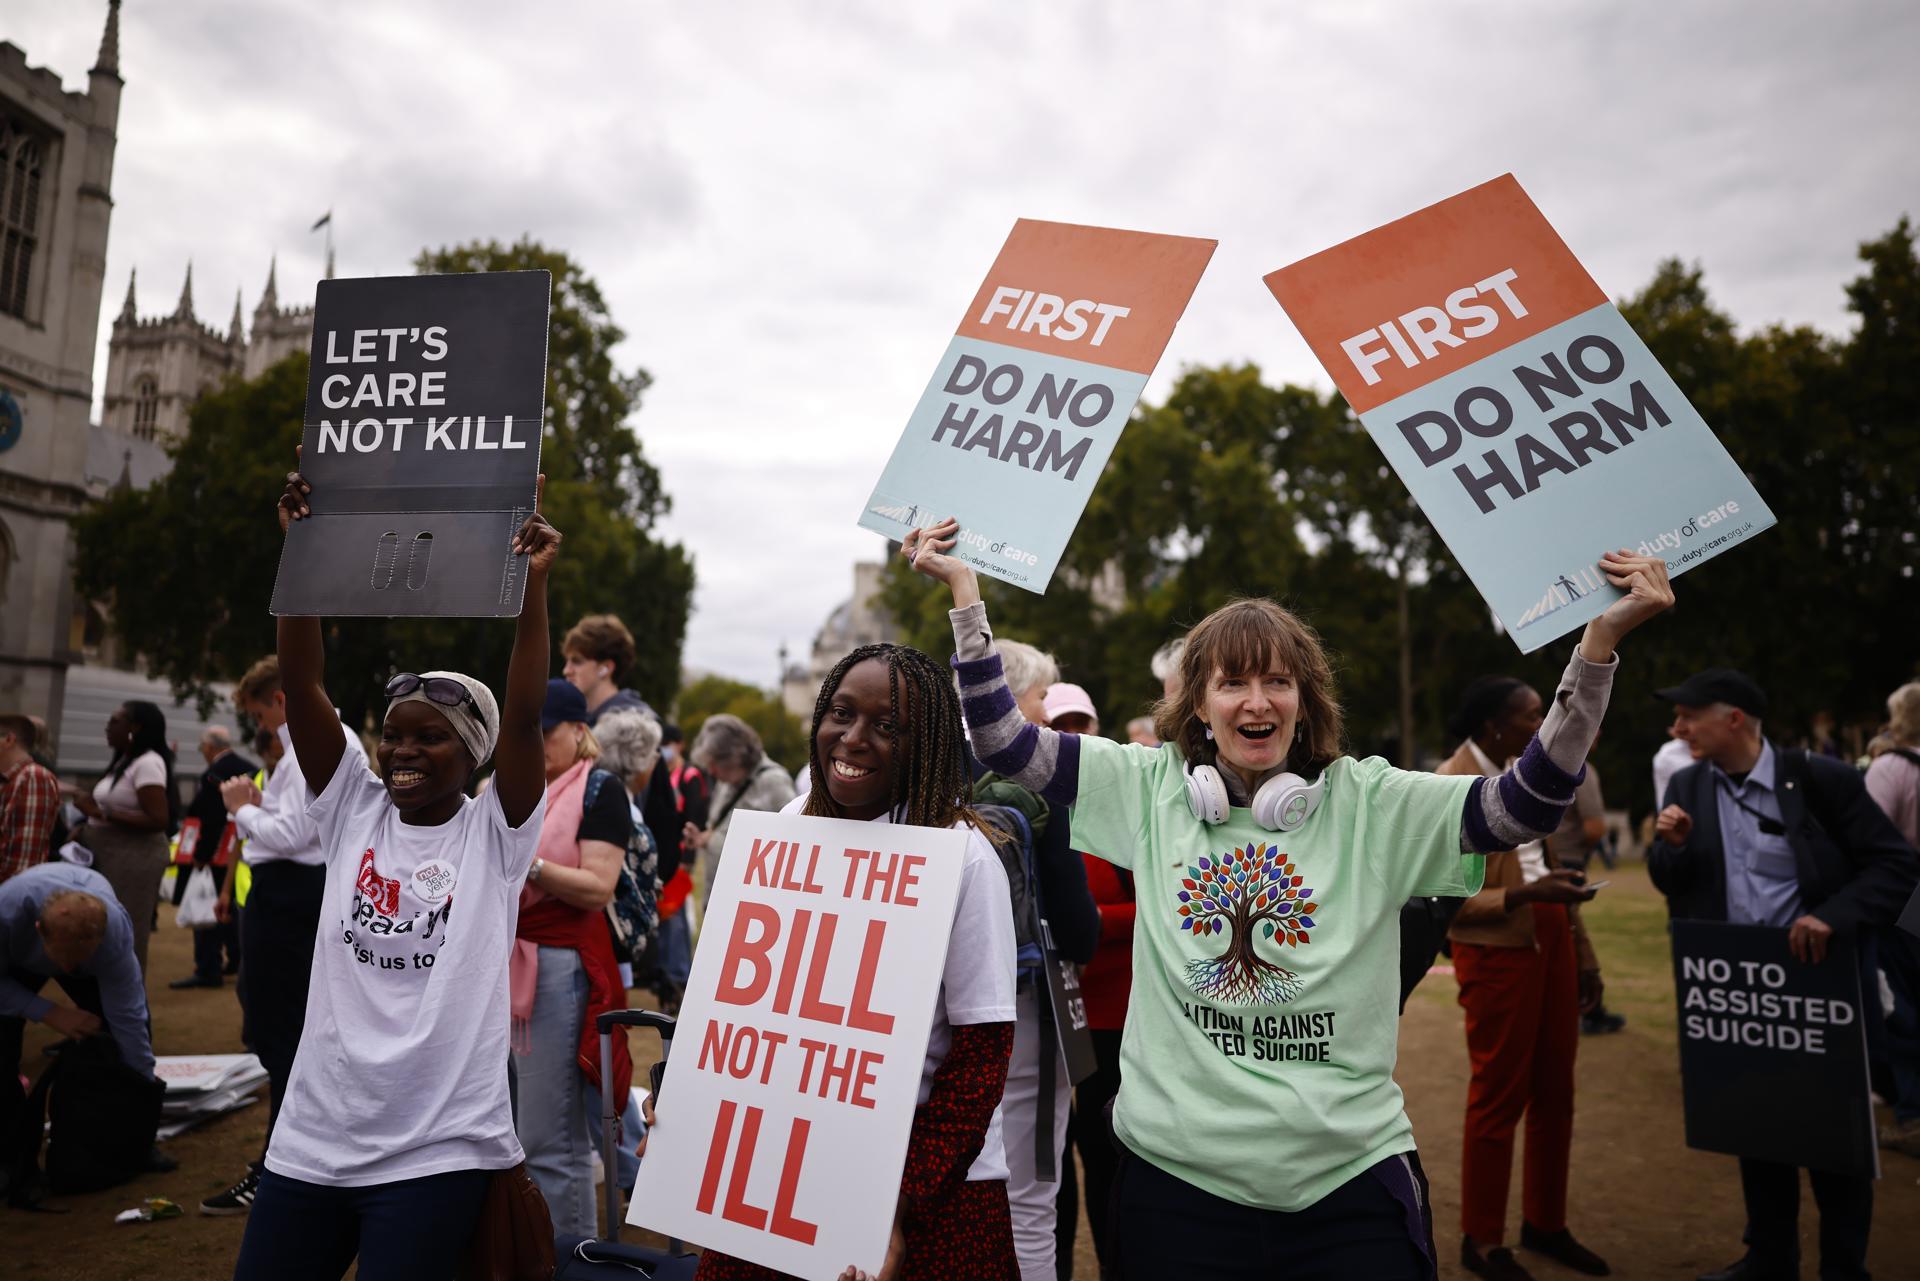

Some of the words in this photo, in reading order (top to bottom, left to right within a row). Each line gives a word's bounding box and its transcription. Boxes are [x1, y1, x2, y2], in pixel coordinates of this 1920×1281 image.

[979, 285, 1131, 347] FIRST
[1339, 268, 1530, 386] FIRST
[325, 326, 449, 364] LET'S
[321, 371, 447, 410] CARE
[942, 354, 1024, 406] DO
[1026, 372, 1115, 428] NO
[1395, 386, 1514, 468] DO
[1511, 334, 1626, 413] NO
[317, 416, 414, 454] NOT
[424, 414, 527, 452] KILL
[931, 402, 1094, 482] HARM
[1451, 379, 1673, 515] HARM
[957, 527, 991, 552] duty
[990, 541, 1008, 555] of
[1003, 545, 1039, 567] care
[1637, 529, 1681, 557] duty
[1681, 517, 1699, 538] of
[1697, 499, 1741, 529] care
[1666, 519, 1754, 571] Ourdutyofcare.org.uk
[419, 866, 438, 880] not
[425, 868, 451, 888] dead
[743, 838, 824, 895] KILL
[842, 848, 927, 907] THE
[380, 956, 406, 970] us
[413, 952, 436, 969] to
[713, 900, 896, 1036] BILL
[1682, 956, 1732, 984] NO
[1739, 961, 1787, 988] TO
[1251, 1011, 1336, 1040] AGAINST
[1684, 986, 1854, 1025] ASSISTED
[1252, 1038, 1331, 1063] SUICIDE
[1686, 1014, 1827, 1054] SUICIDE
[697, 1019, 788, 1085] NOT
[798, 1037, 884, 1110] THE
[695, 1099, 819, 1247] ILL
